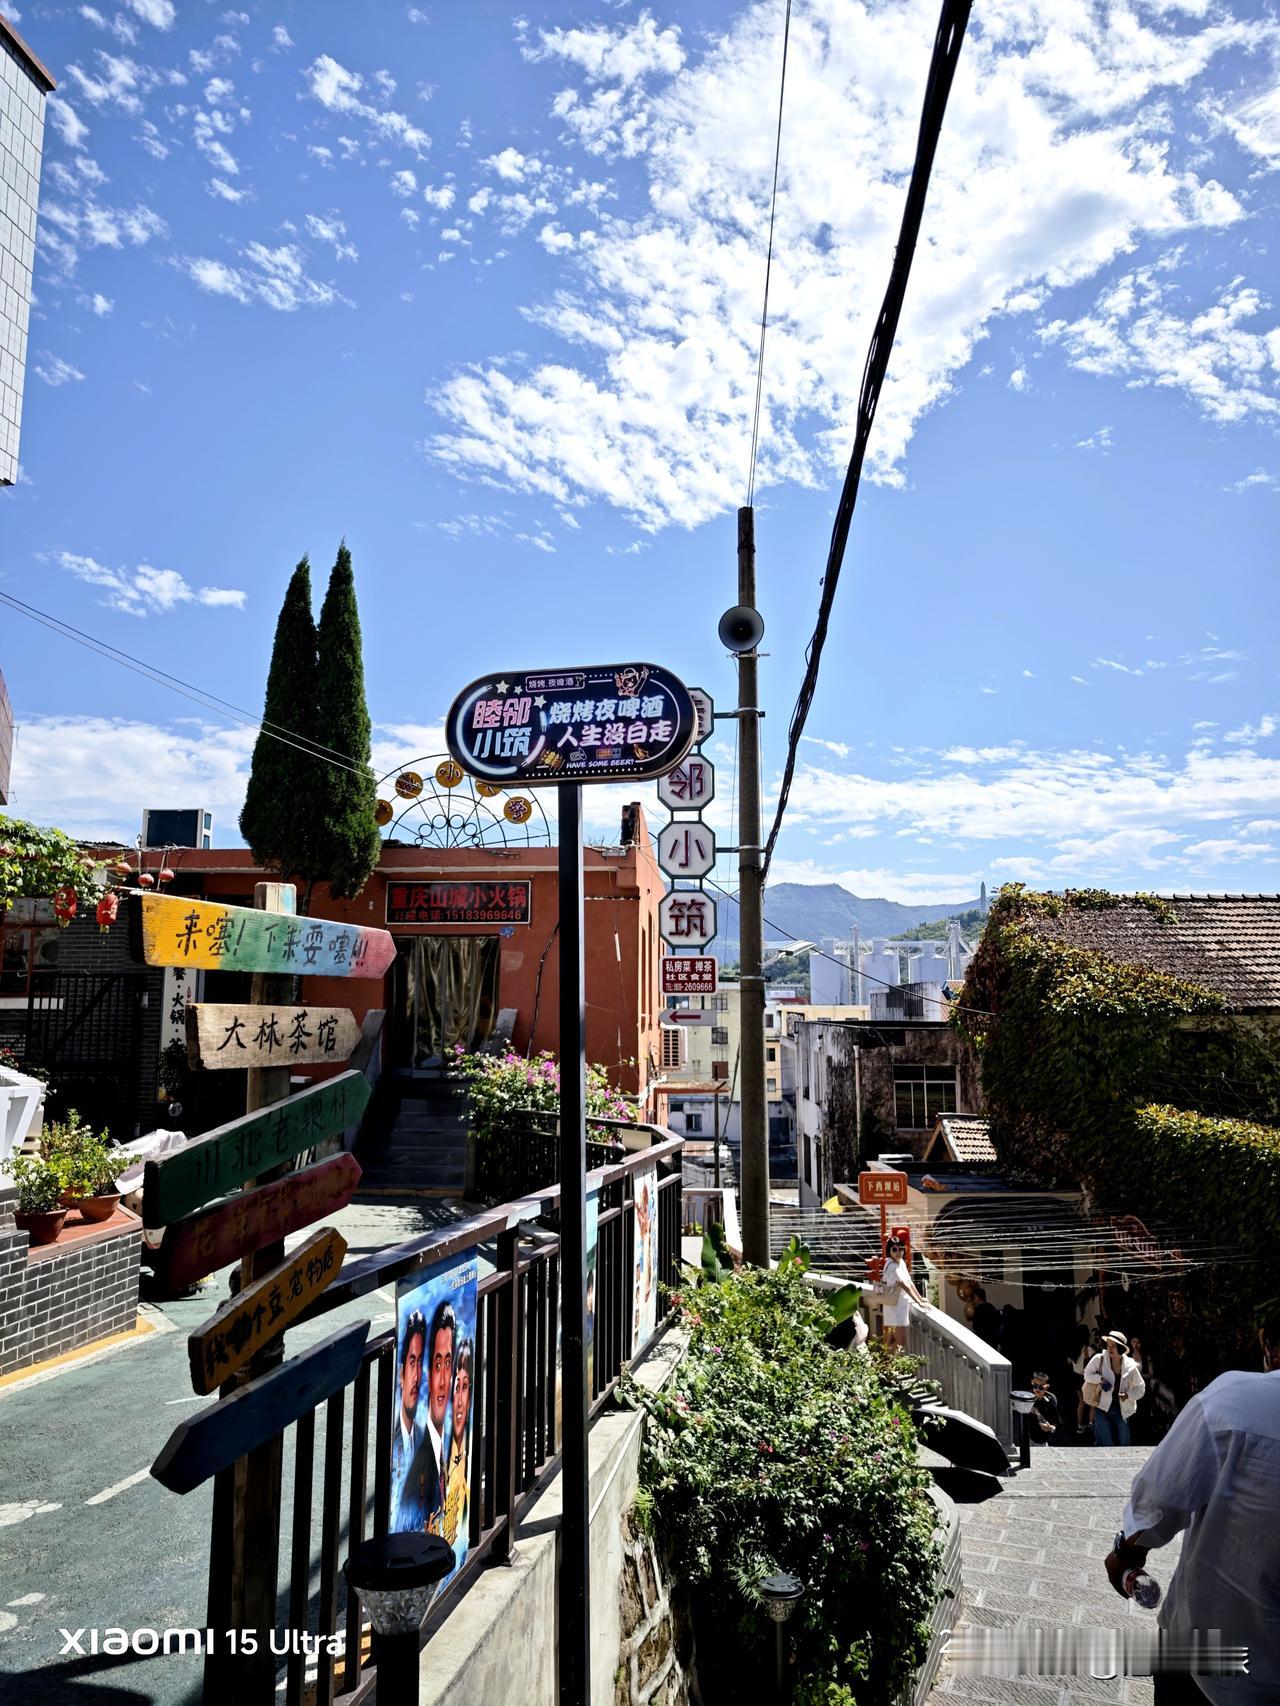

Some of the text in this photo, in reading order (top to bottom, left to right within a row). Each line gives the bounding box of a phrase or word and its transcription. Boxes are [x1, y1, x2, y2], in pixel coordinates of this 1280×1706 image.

[472, 697, 532, 729] 睦邻
[549, 695, 665, 725] 烧烤夜啤酒
[472, 727, 532, 758] 小筑
[557, 719, 673, 748] 人生没白走
[588, 760, 609, 768] SOME
[610, 758, 635, 767] BEER?
[390, 885, 527, 909] 重庆山城小火锅
[665, 961, 691, 973] 私房菜
[665, 973, 713, 981] 社区食堂
